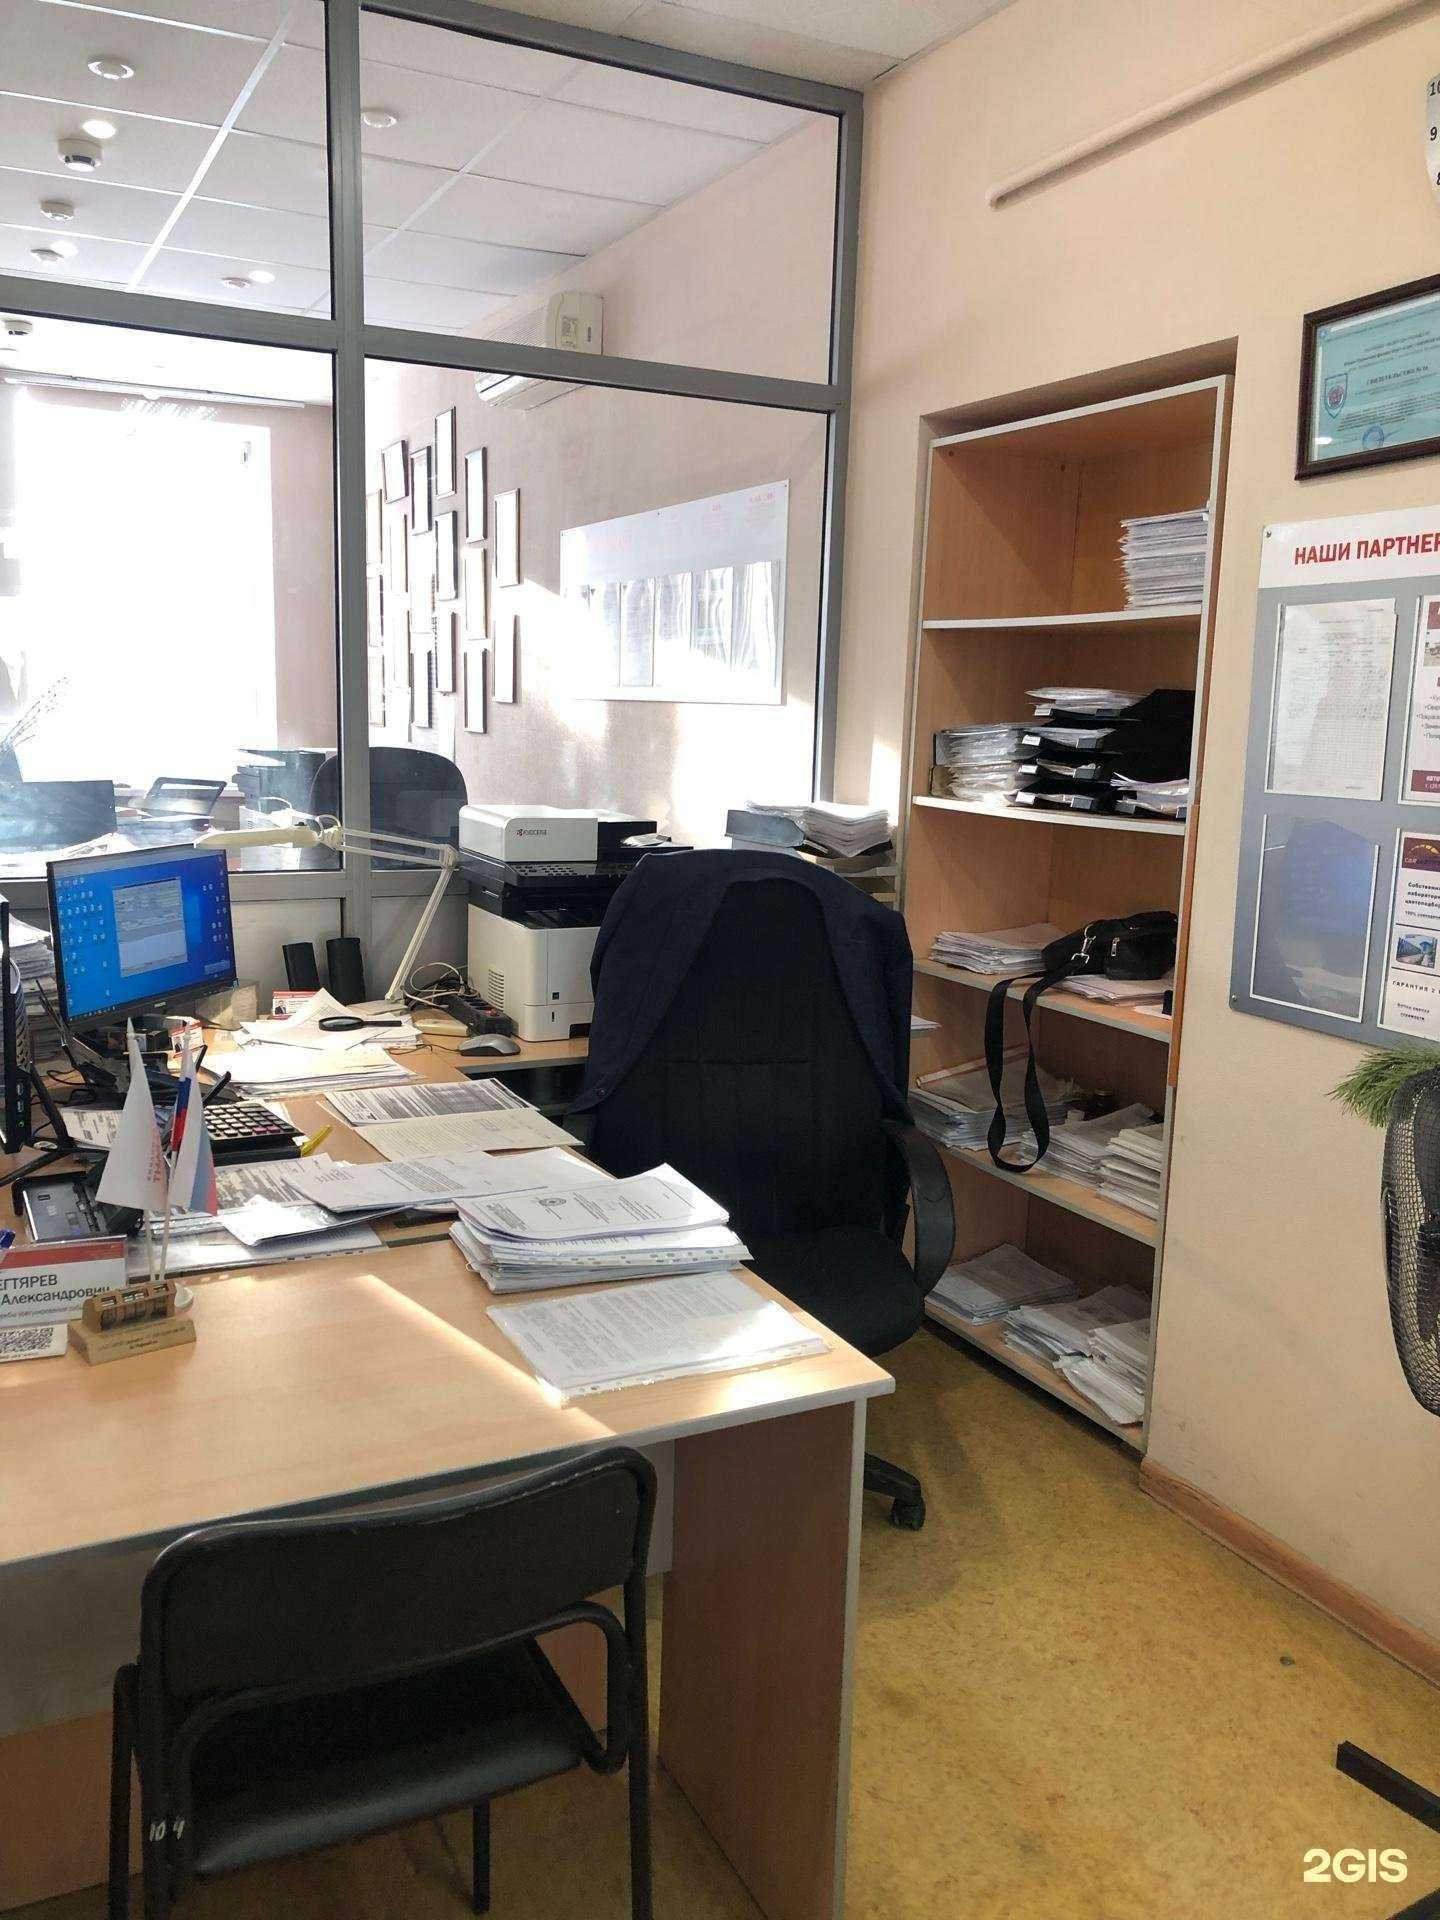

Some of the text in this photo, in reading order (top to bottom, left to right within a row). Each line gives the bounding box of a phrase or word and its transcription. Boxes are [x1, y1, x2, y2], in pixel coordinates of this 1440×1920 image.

[1430, 126, 1438, 141] 9
[1294, 543, 1351, 565] НАШИ
[1392, 980, 1429, 992] ГАРАНТИЯ
